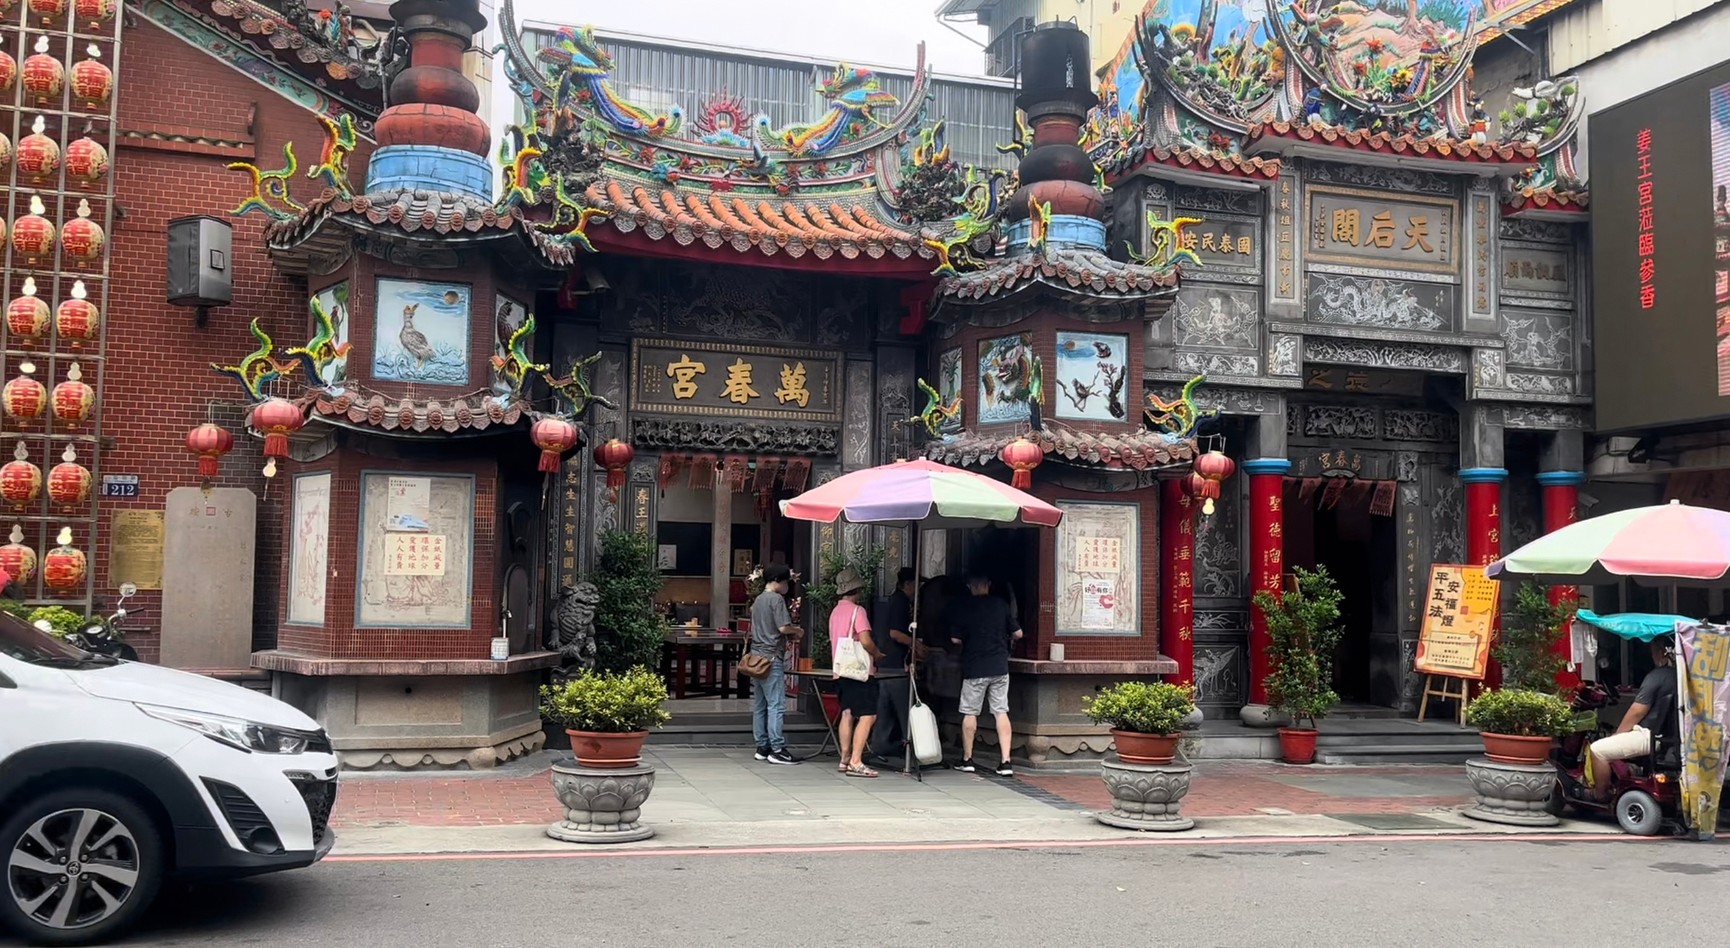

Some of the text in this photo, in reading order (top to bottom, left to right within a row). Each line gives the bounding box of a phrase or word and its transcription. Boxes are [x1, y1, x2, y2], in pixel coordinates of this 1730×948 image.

[667, 354, 811, 408] 萬春宮
[111, 484, 135, 496] 212
[1178, 494, 1192, 641] 母儀垂範千秋
[1268, 495, 1281, 605] 聖德留芳
